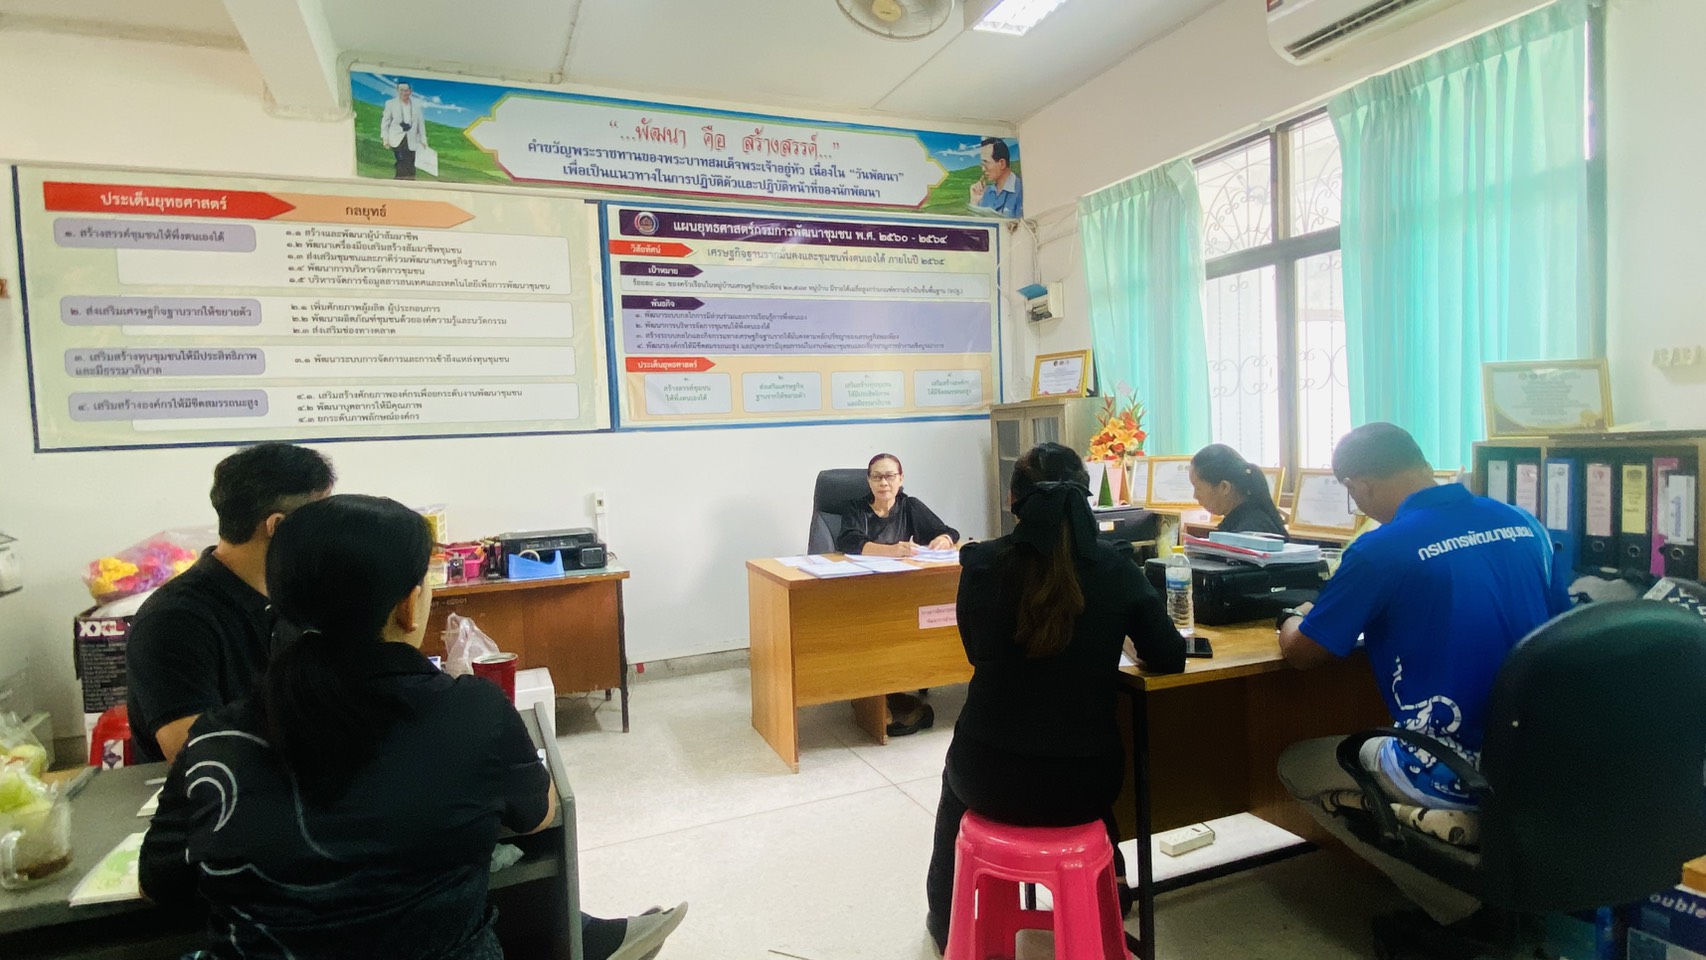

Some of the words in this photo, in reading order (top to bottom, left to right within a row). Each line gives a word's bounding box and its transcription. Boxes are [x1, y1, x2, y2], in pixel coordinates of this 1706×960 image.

[701, 125, 726, 151] คือ
[528, 139, 805, 178] คำขวัญพระราชทานของพระบาทสมเด็จพระเจ้าอยู่หัว
[809, 164, 846, 179] เนื่องใน
[849, 167, 904, 183] “วันพัฒนา”
[562, 160, 881, 199] เพื่อเป็นแนวทางในการปฏิบัติตัวและปฏิบัติหน้าที่ของนักพัฒนา
[100, 191, 228, 213] ประเด็นยุทธศาสตร์
[345, 204, 387, 221] กลยุทธ์
[80, 226, 225, 243] สร้างสรรค์ชุมชนให้พึ่งตนเองได้
[304, 228, 419, 242] สร้างและพัฒนาผู้นำสัมมาชีพ
[673, 221, 852, 243] แผนยุทธศาสตร์กรมการพัฒนาชุมชน
[856, 230, 876, 241] พ.ศ.
[879, 232, 909, 243] ๒๕๖๐
[305, 239, 462, 256] พัฒนาเครื่องมือเสริมสร้างสัมมาชีพชุมชน
[630, 245, 661, 254] วิสัยทัศน์
[707, 248, 886, 263] เศรษฐกิจฐานรากมั่นคงและชุมชนพึ่งตนเองได้
[888, 252, 918, 264] ภายในปี
[307, 263, 425, 277] พัฒนาการบริหารจัดการชุมชน
[648, 266, 679, 276] เป้าหมาย
[310, 300, 385, 314] เพิ่มศักยภาพผู้ผลิต
[388, 303, 440, 314] ผู้ประกอบการ
[650, 298, 675, 308] พันธกิจ
[86, 306, 252, 320] ส่งเสริมเศรษฐกิจฐานรากให้ขยายตัว
[311, 314, 507, 326] พัฒนาผลิตภัณฑ์ชุมชนด้วยองค์ความรู้และนวัตกรรม
[312, 325, 396, 334] ส่งเสริมช่องทางตลาด
[89, 350, 257, 364] เสริมสร้างทุนชุมชนให้มีประสิทธิภาพ
[314, 354, 510, 365] พัฒนาระบบการจัดการและการเข้าถึงแหล่งทุนชุมชน
[75, 364, 163, 375] และมีธรรมาภิบาล
[638, 359, 697, 370] ประเด็นยุทธศาสตร์
[93, 399, 259, 411] เสริมสร้างองค์กรให้มีขีดสมรรถนะสูง
[316, 401, 423, 412] พัฒนาบุคลากรให้มีคุณภาพ
[317, 412, 420, 422] ยกระดับภาพลักษณ์องค์กร
[1418, 526, 1534, 560] กรมการพัฒนาชุมชน
[79, 621, 125, 636] XXL
